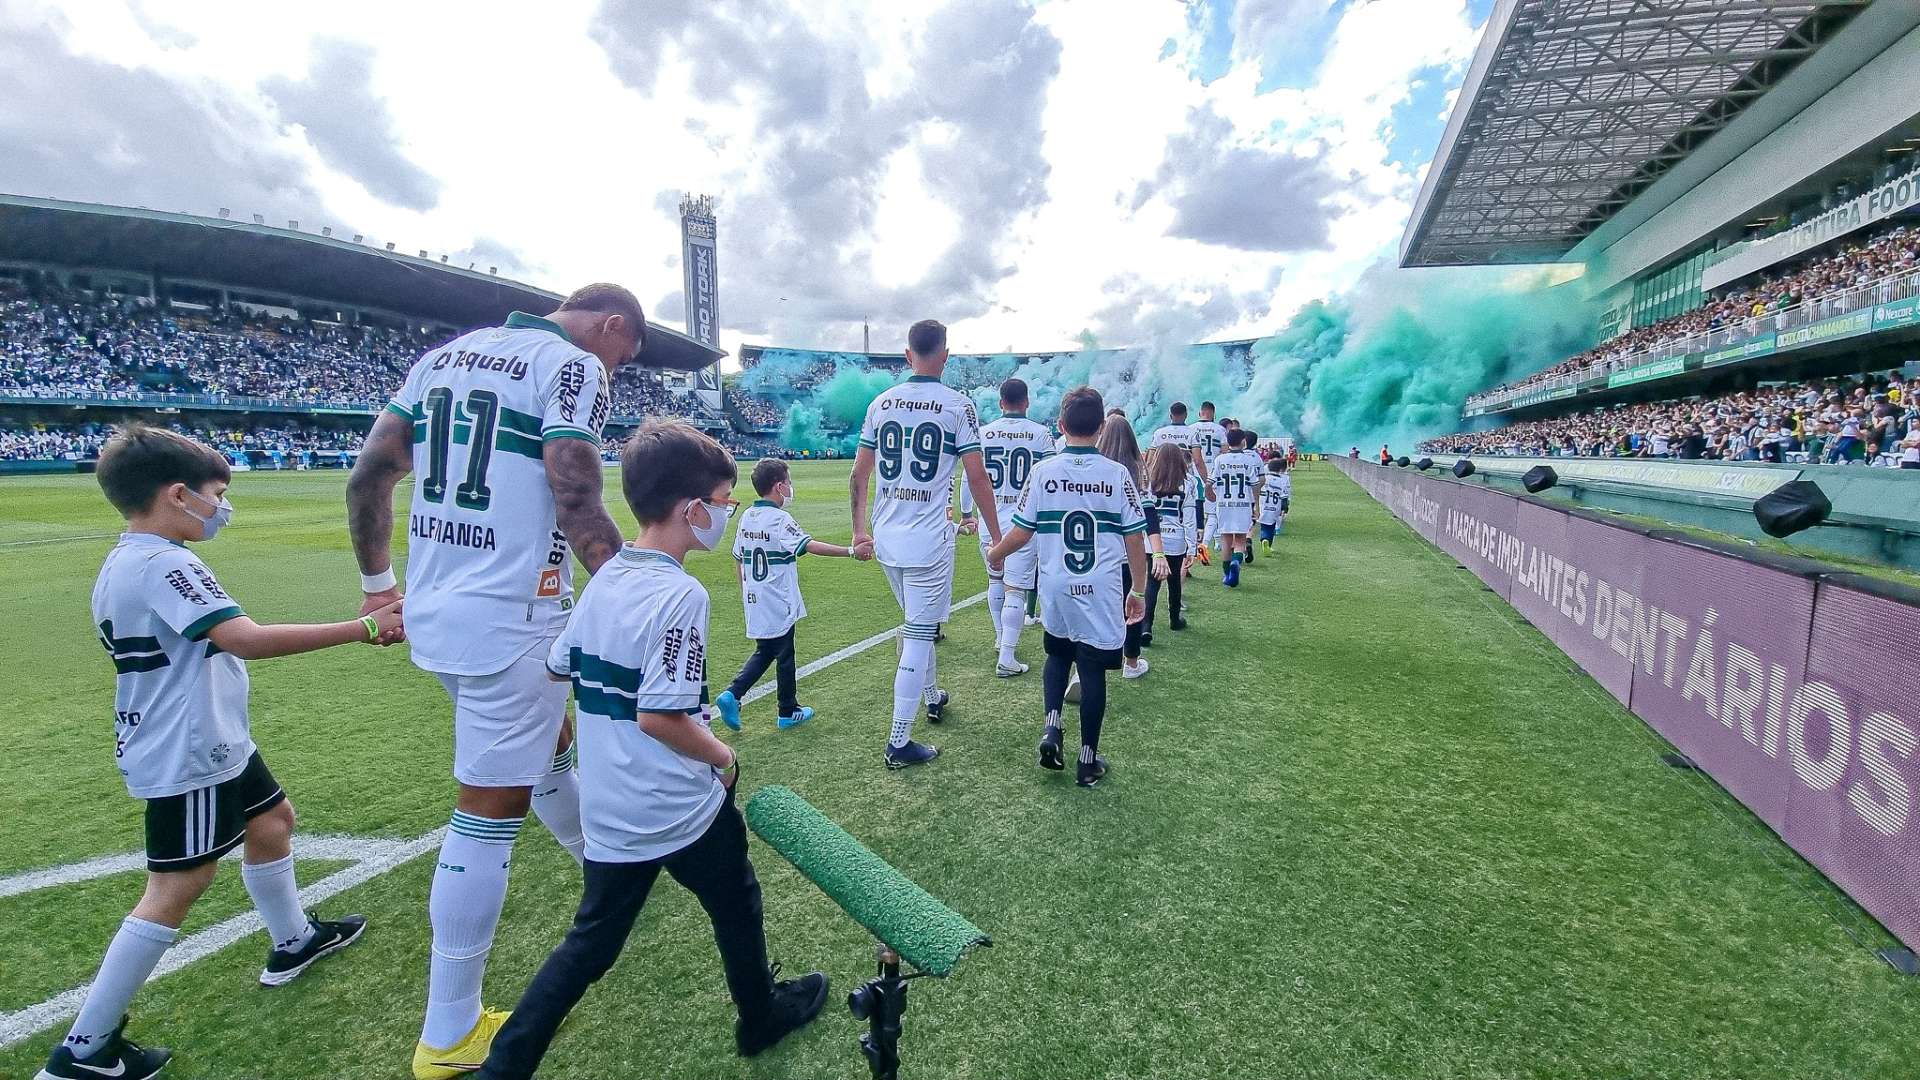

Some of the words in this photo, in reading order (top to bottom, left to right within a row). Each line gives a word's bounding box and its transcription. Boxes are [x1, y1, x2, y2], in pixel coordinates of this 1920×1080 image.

[697, 248, 709, 303] TORK
[895, 399, 942, 414] Tequaly
[423, 387, 499, 512] 11
[879, 420, 943, 483] 99
[997, 430, 1034, 441] Tequaly
[984, 446, 1033, 491] 50
[1060, 479, 1113, 497] Tequaly
[1222, 473, 1245, 498] 11
[1063, 510, 1097, 575] 9
[1070, 584, 1094, 596] LUCA
[662, 627, 675, 666] TORK
[672, 628, 684, 660] PRO
[692, 644, 703, 683] TORK
[685, 650, 696, 682] PRO
[1452, 510, 1480, 553] MARCA
[1481, 522, 1497, 564] DE
[1497, 531, 1590, 626] IMPLANTES
[1592, 579, 1920, 837] DENTÁRIOS
